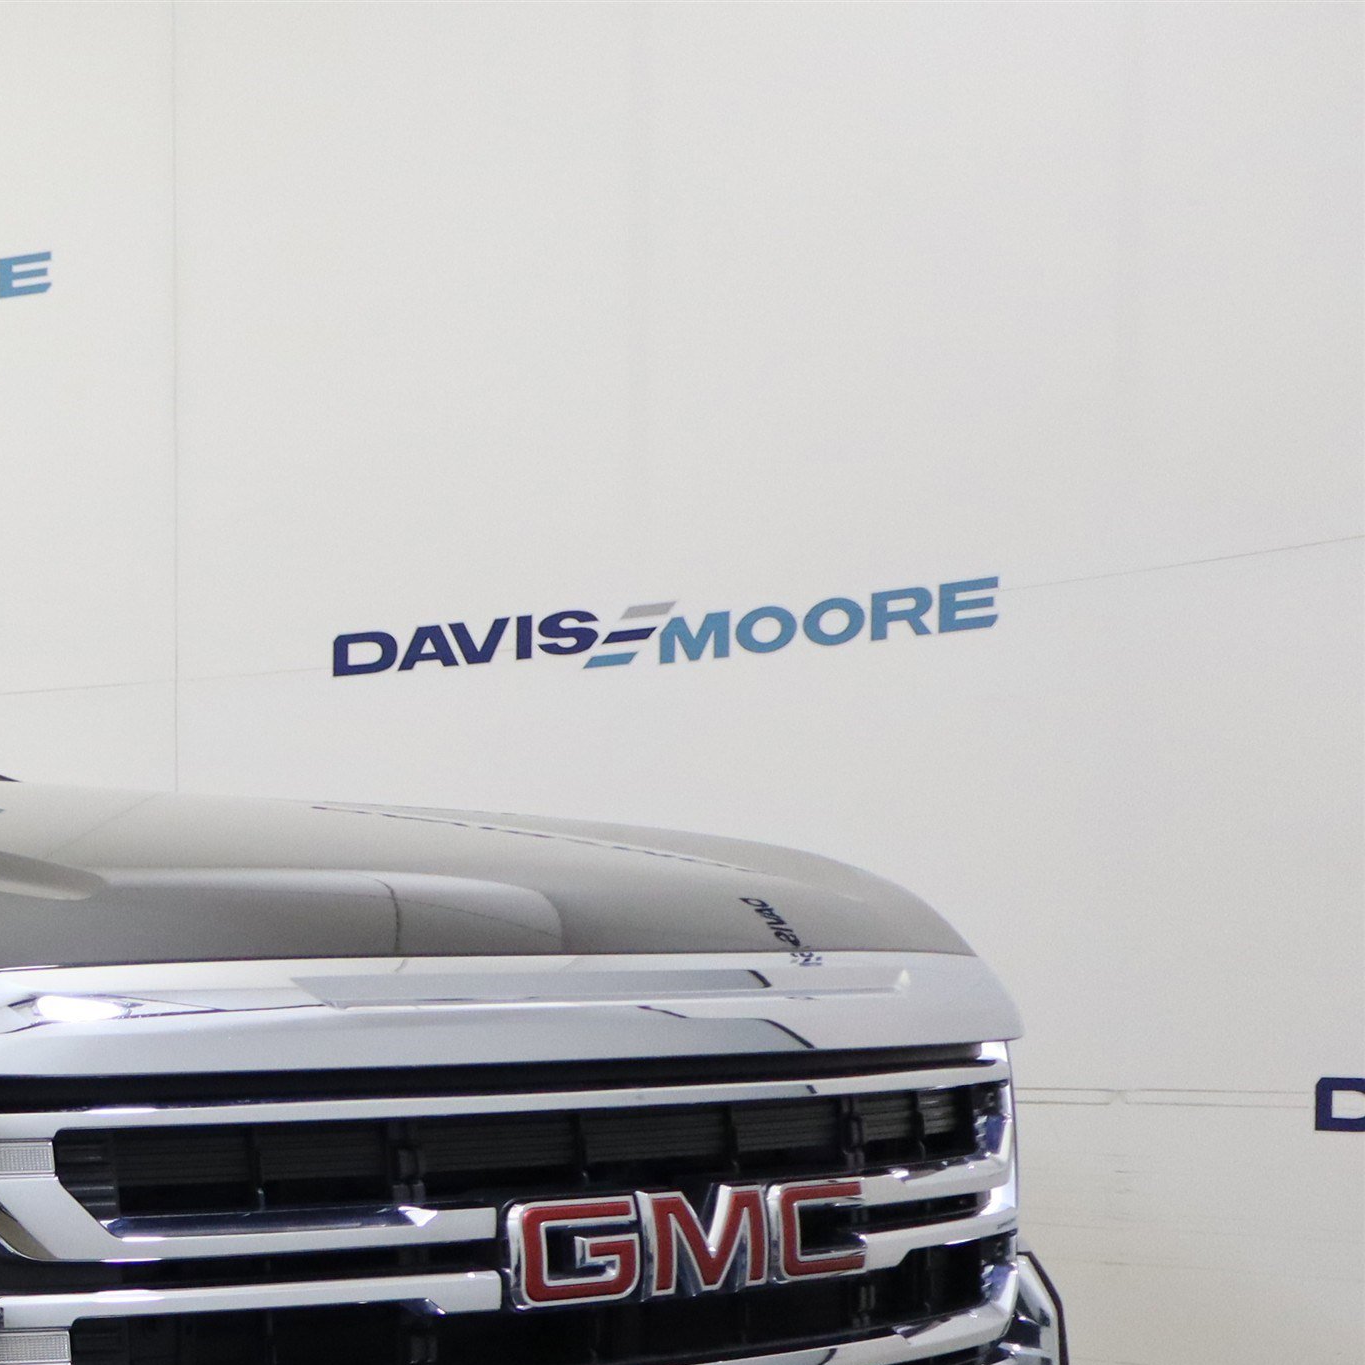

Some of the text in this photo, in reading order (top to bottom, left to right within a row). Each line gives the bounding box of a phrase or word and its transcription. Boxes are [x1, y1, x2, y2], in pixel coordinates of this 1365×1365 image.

[332, 575, 1000, 677] DAVIS MOORE
[507, 1174, 868, 1312] GMC
